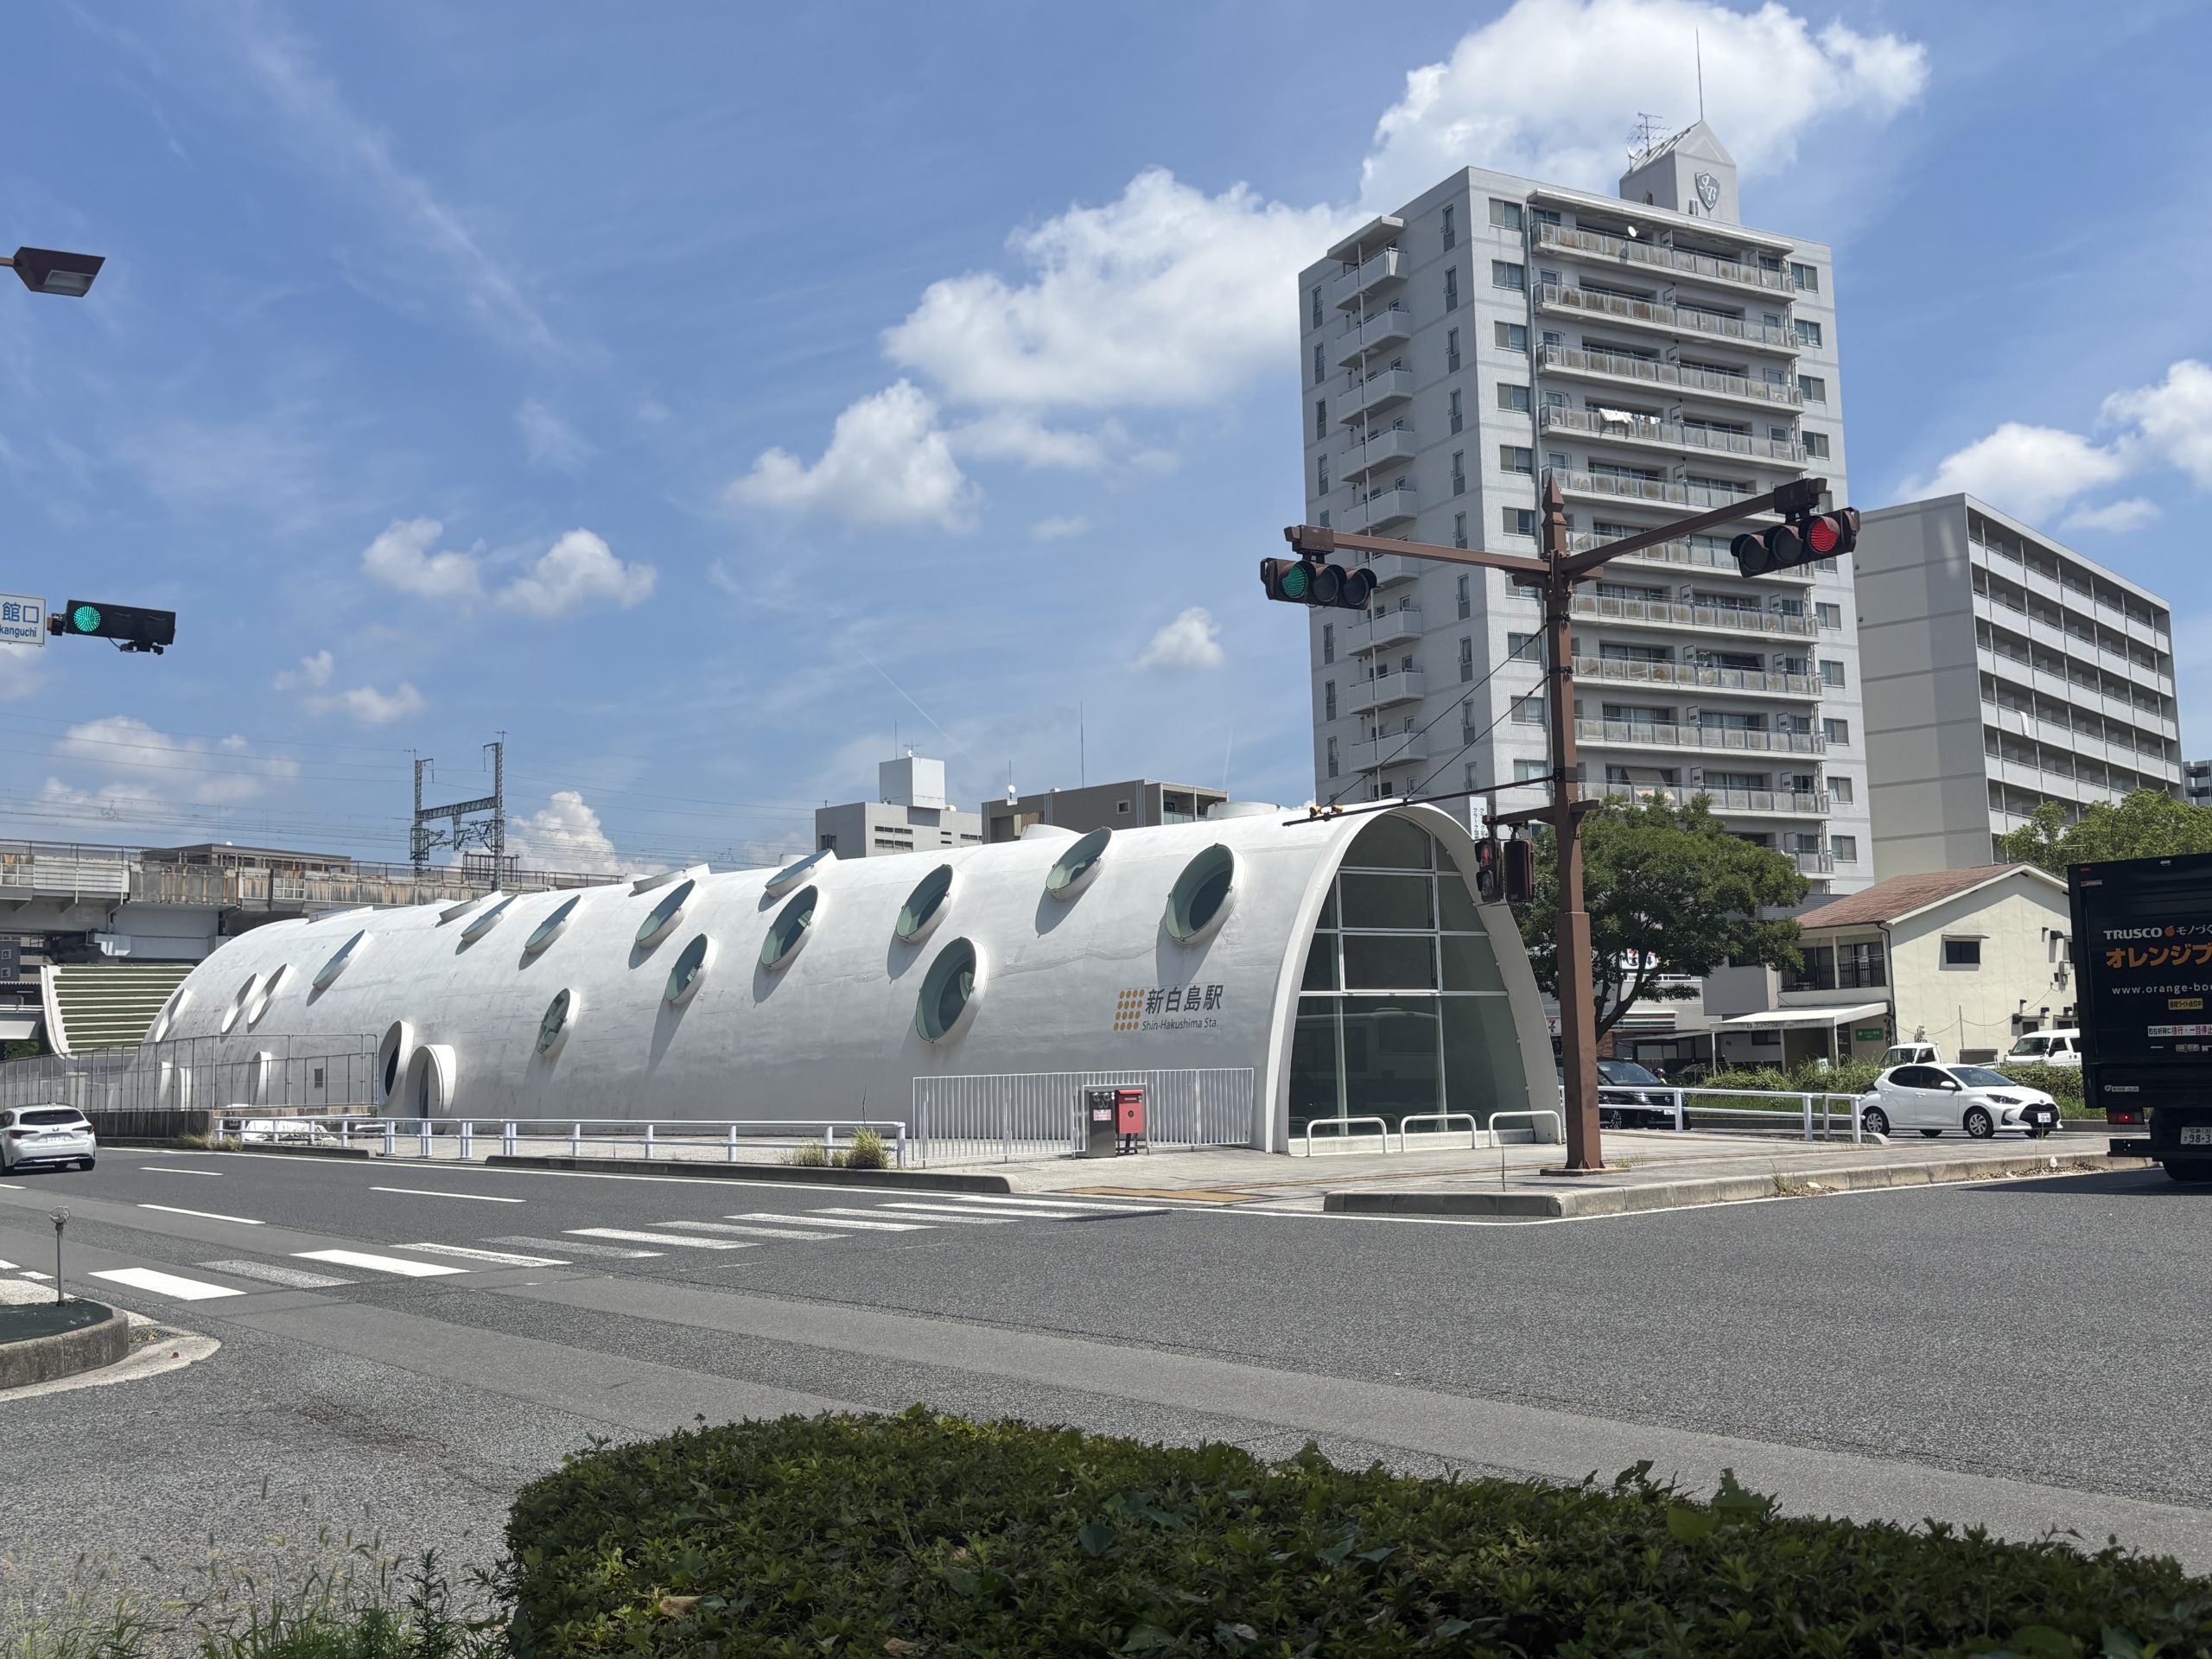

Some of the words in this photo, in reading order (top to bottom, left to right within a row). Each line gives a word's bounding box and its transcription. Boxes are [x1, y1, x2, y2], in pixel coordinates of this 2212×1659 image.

[2103, 927, 2163, 940] TRUSCO
[2106, 943, 2212, 969] オレンジブ
[1145, 984, 1224, 1014] 新白島駅
[1141, 1019, 1203, 1031] Shin-Hakushima
[1204, 1017, 1218, 1029] Sta.
